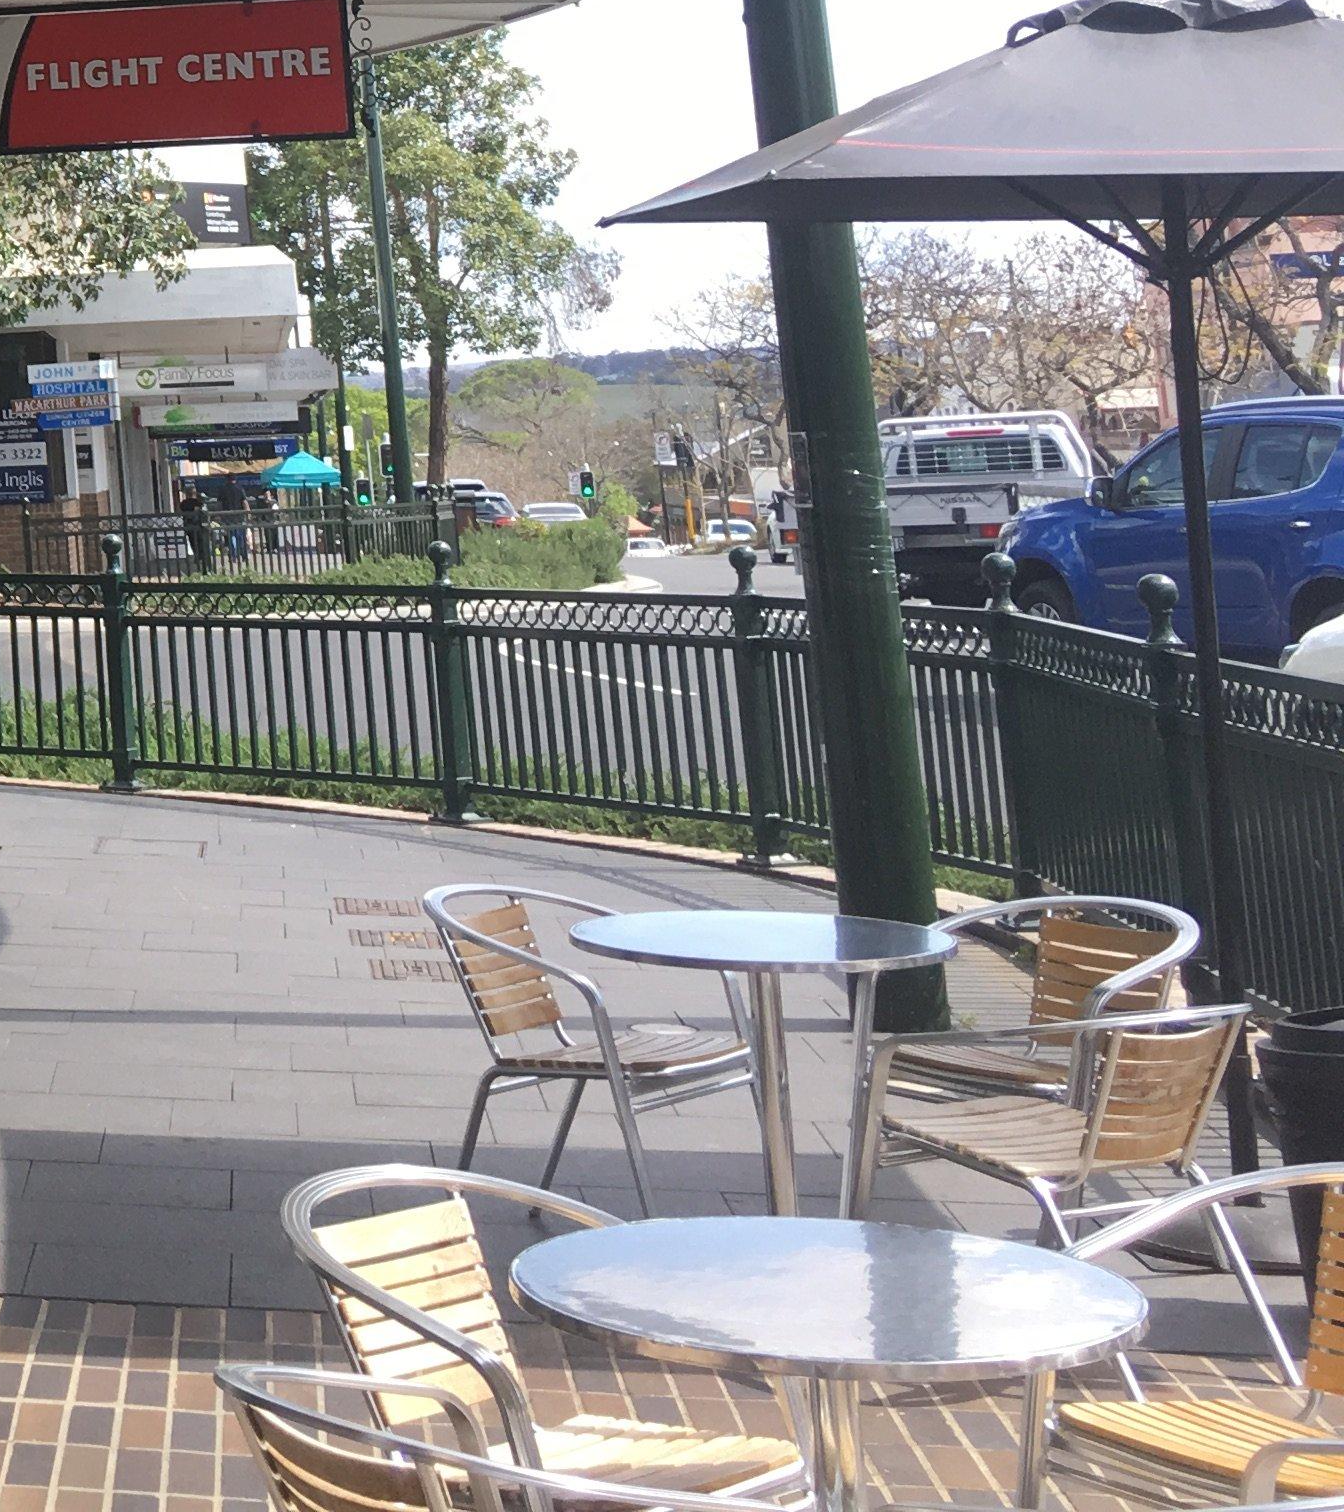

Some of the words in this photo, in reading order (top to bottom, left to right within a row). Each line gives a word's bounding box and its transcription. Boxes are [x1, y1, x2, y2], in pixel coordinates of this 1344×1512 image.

[27, 57, 163, 91] FLIGHT
[177, 47, 331, 82] CENTRE
[34, 367, 73, 379] JOHN
[158, 367, 193, 381] Family
[198, 366, 234, 379] Focus
[37, 381, 105, 395] HOSPITAL
[15, 398, 76, 413] MACARTHUR
[80, 395, 107, 408] PARK
[12, 448, 42, 459] 3322
[171, 446, 189, 456] Blo
[5, 469, 44, 491] Inglis
[940, 496, 980, 505] NISSAN
